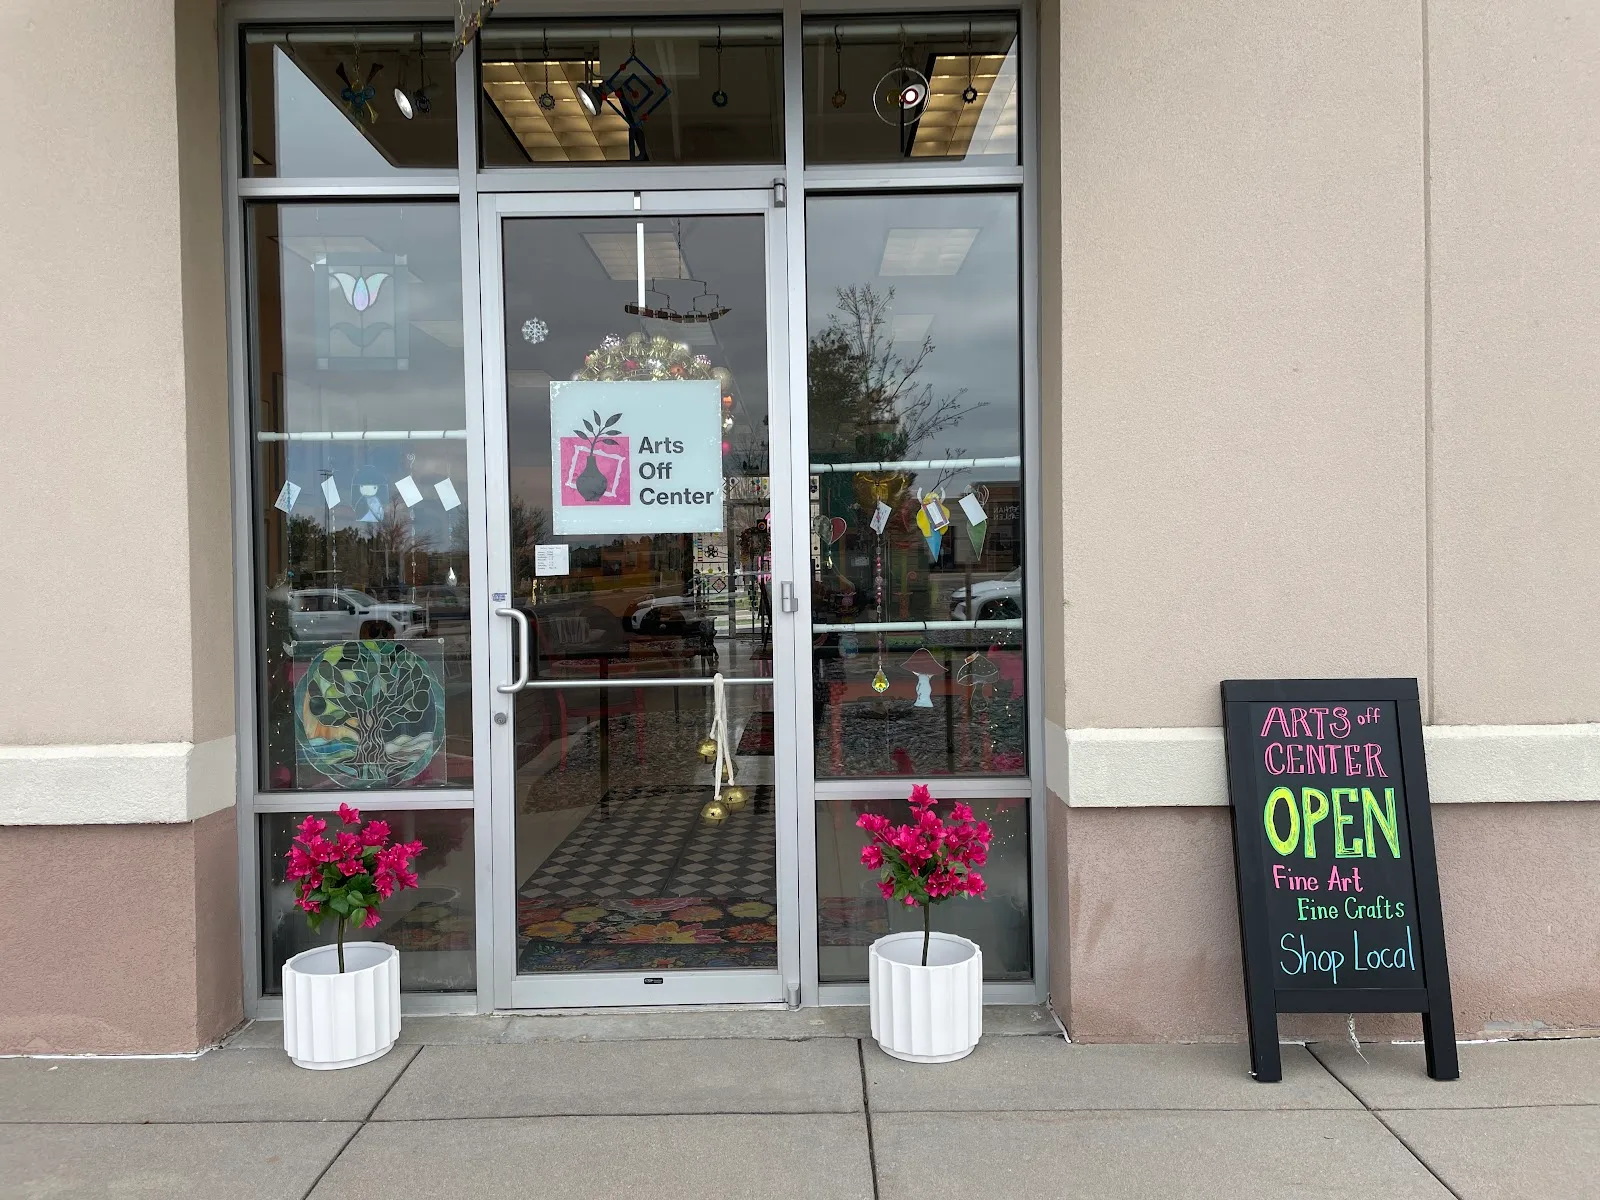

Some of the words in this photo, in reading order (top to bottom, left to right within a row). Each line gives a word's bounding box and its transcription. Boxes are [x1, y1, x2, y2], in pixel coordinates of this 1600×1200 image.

[639, 437, 683, 454] Arts
[639, 461, 672, 479] Off
[639, 488, 714, 505] Center
[1260, 707, 1352, 740] ARTS
[1357, 707, 1381, 725] off
[1265, 742, 1388, 777] CENTER
[1264, 787, 1400, 858] OPEN
[1272, 865, 1319, 891] Fine
[1328, 865, 1363, 892] Art
[1297, 897, 1338, 920] Fine
[1345, 896, 1405, 919] Crafts
[1280, 932, 1344, 984] Shop
[1354, 926, 1416, 971] Local
